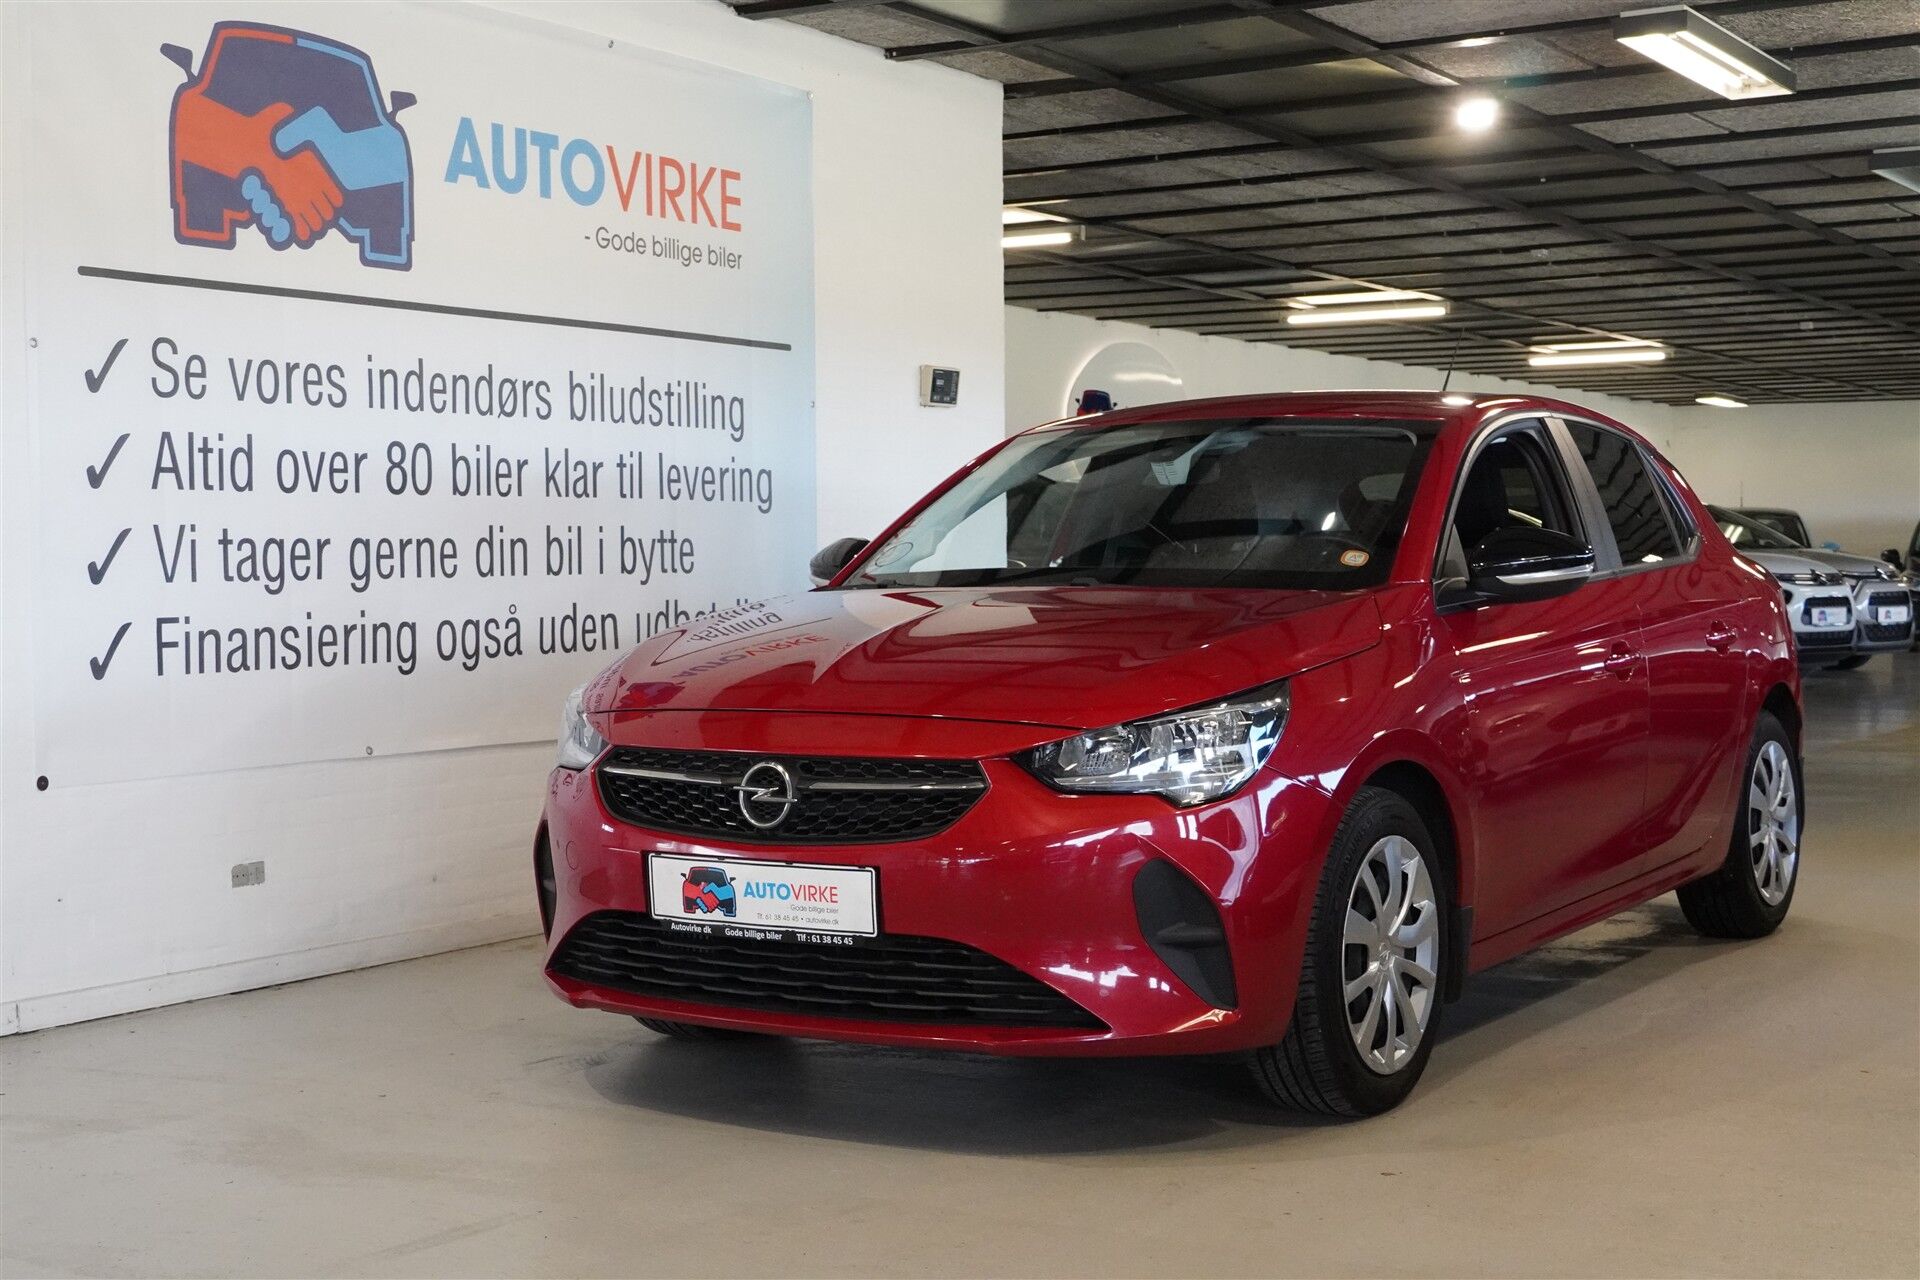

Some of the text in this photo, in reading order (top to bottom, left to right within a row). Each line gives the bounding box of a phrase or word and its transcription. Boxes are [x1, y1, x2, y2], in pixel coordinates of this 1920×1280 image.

[444, 116, 742, 233] AUTOVIRKE
[596, 227, 646, 254] Gode
[653, 236, 702, 267] billige
[708, 245, 741, 269] biler
[152, 337, 744, 442] Se vores indendørs biludstilling
[152, 432, 772, 514] Altid over 80 biler klar til levering
[153, 524, 694, 595] Vi tager gerne din bil i bytte
[157, 610, 416, 676] Finansiering
[437, 604, 523, 671] også
[540, 603, 619, 655] uden
[743, 882, 839, 903] AUTOVIRKE
[791, 904, 807, 912] Gode
[808, 906, 825, 914] billige
[670, 922, 702, 933] Autovirke
[725, 928, 743, 938] Gode
[744, 929, 764, 940] billige
[766, 931, 782, 941] biler
[811, 935, 820, 943] 61
[822, 936, 831, 944] 38
[833, 937, 842, 945] 45
[843, 938, 853, 946] 45
